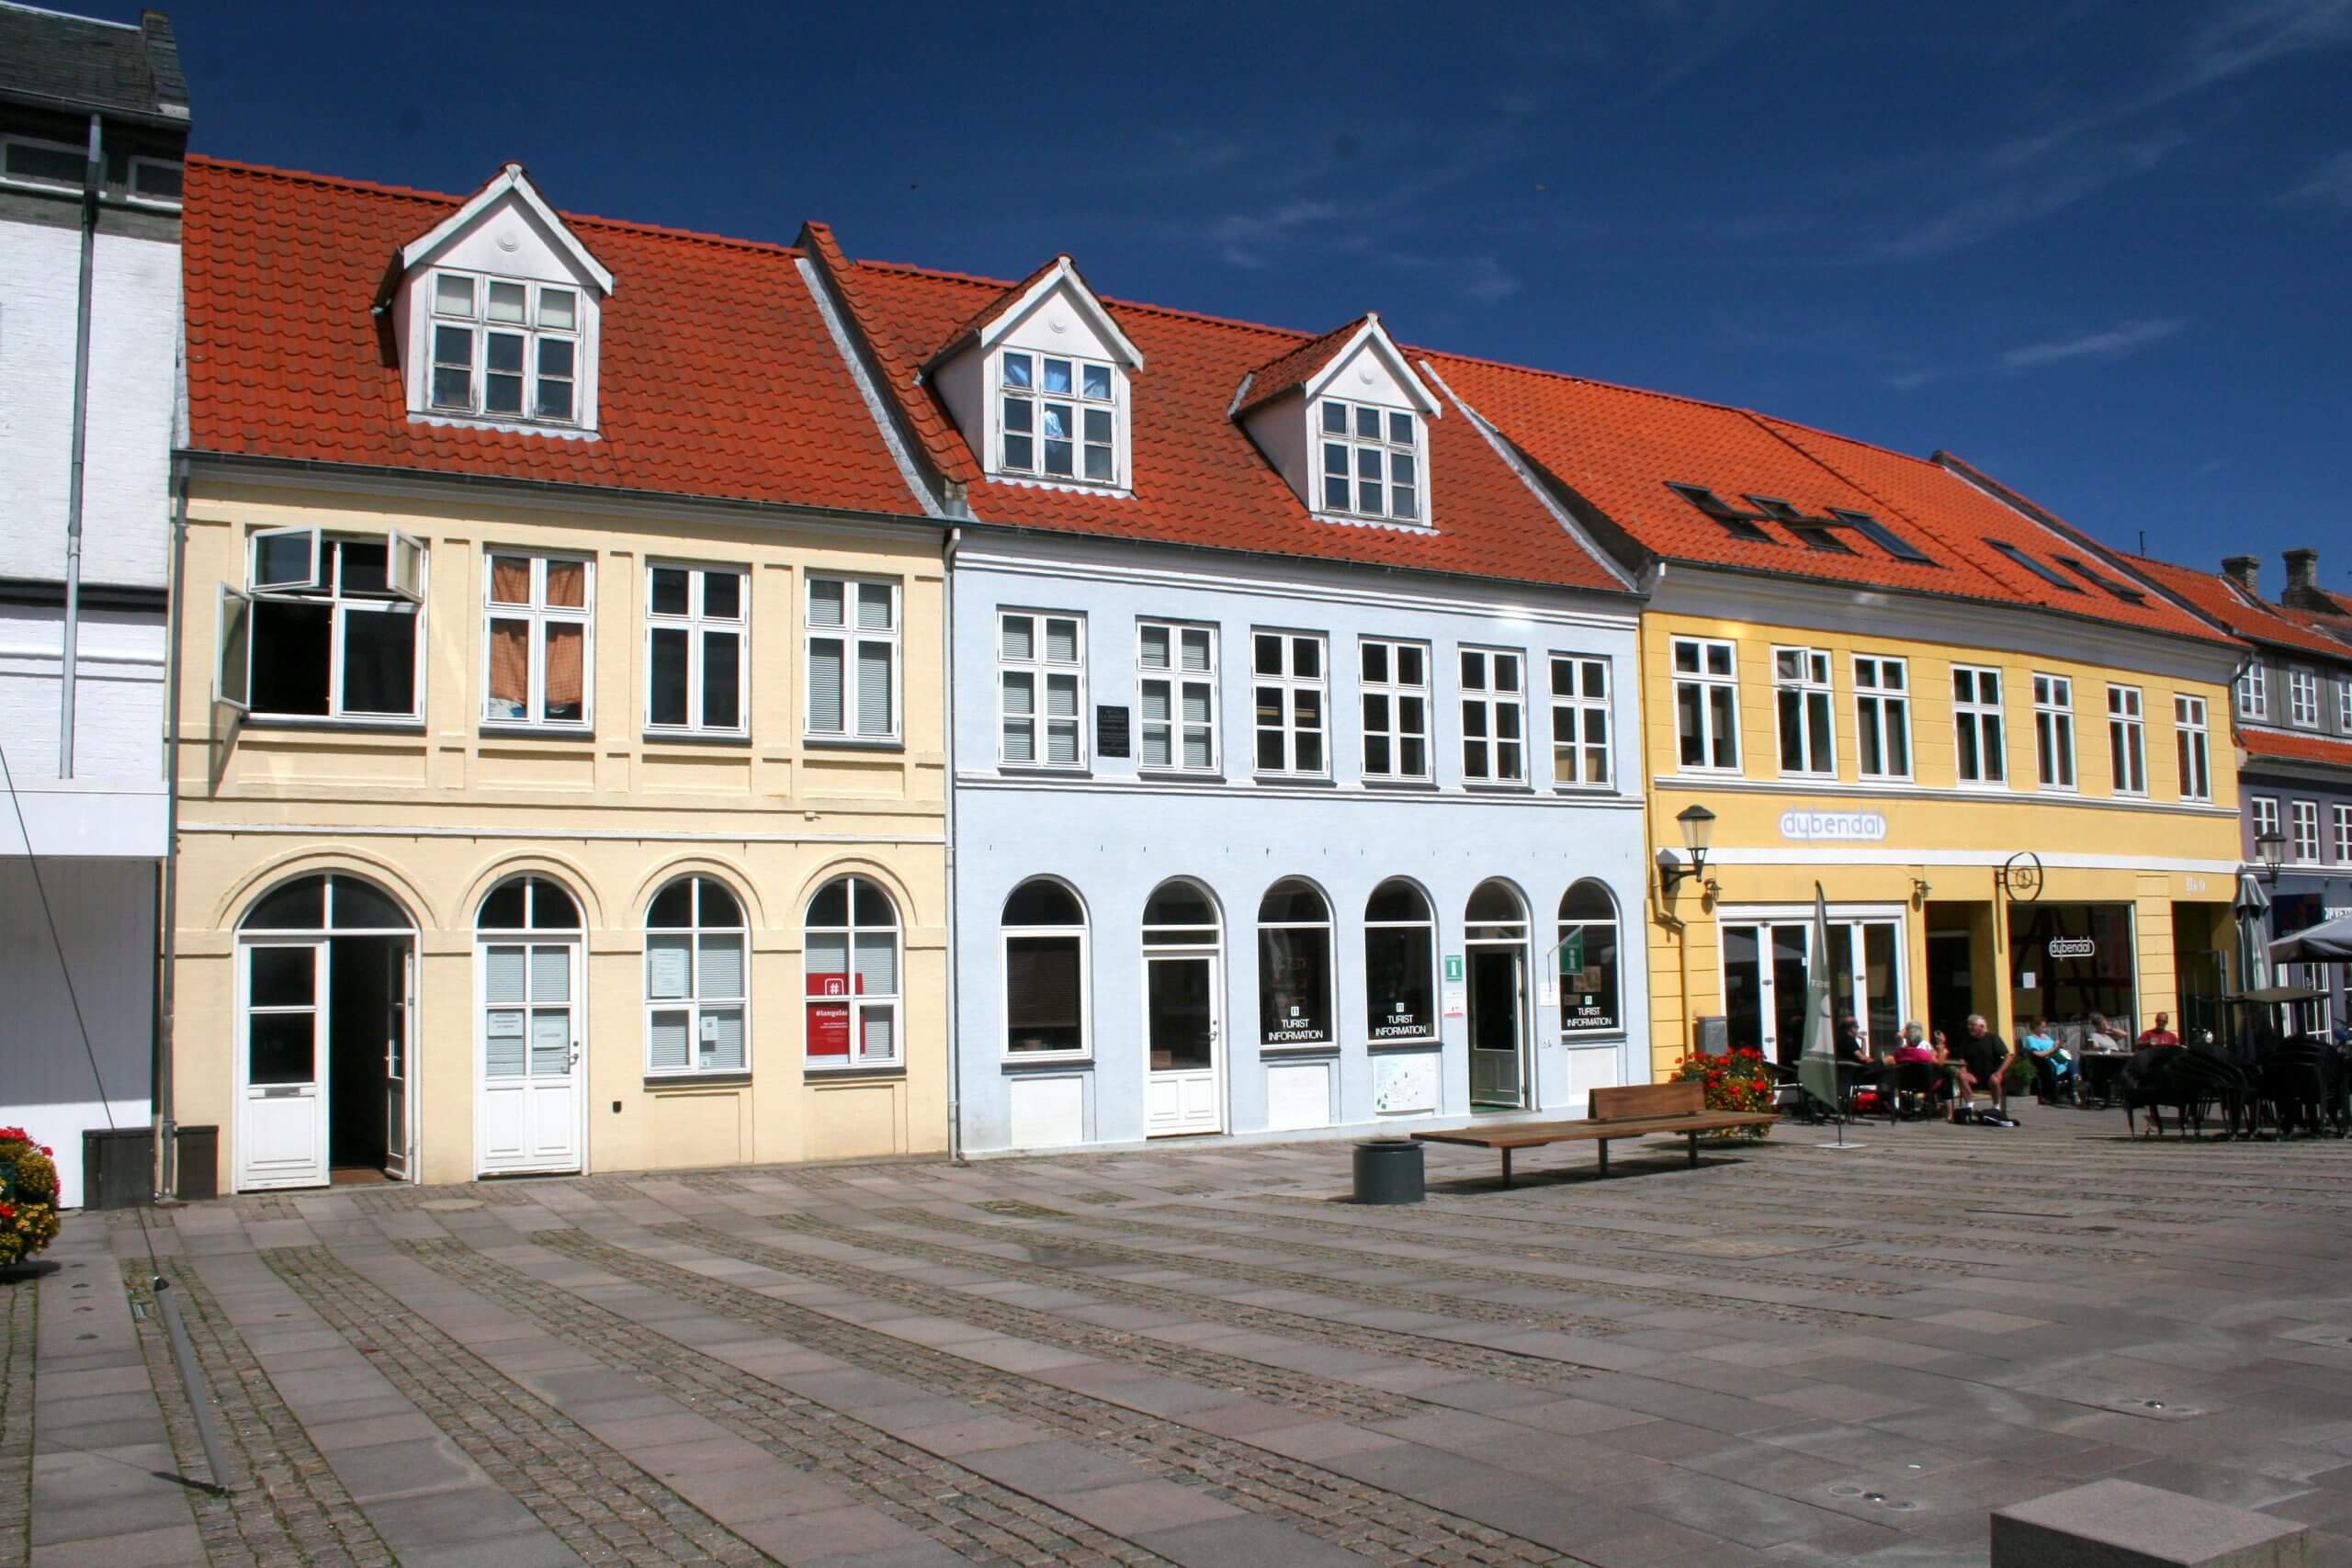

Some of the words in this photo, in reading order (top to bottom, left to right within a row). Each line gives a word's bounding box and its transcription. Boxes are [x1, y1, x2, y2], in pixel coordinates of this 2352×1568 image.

[1783, 805, 1881, 842] dybendal
[2051, 937, 2091, 961] dybendal
[1577, 1007, 1600, 1016] TURIST
[1282, 1019, 1309, 1029] TURIST
[1387, 1014, 1413, 1024] TURIST
[1566, 1017, 1612, 1027] INFORMATION
[1268, 1030, 1323, 1041] INFORMATION
[1375, 1025, 1426, 1036] INFORMATION
